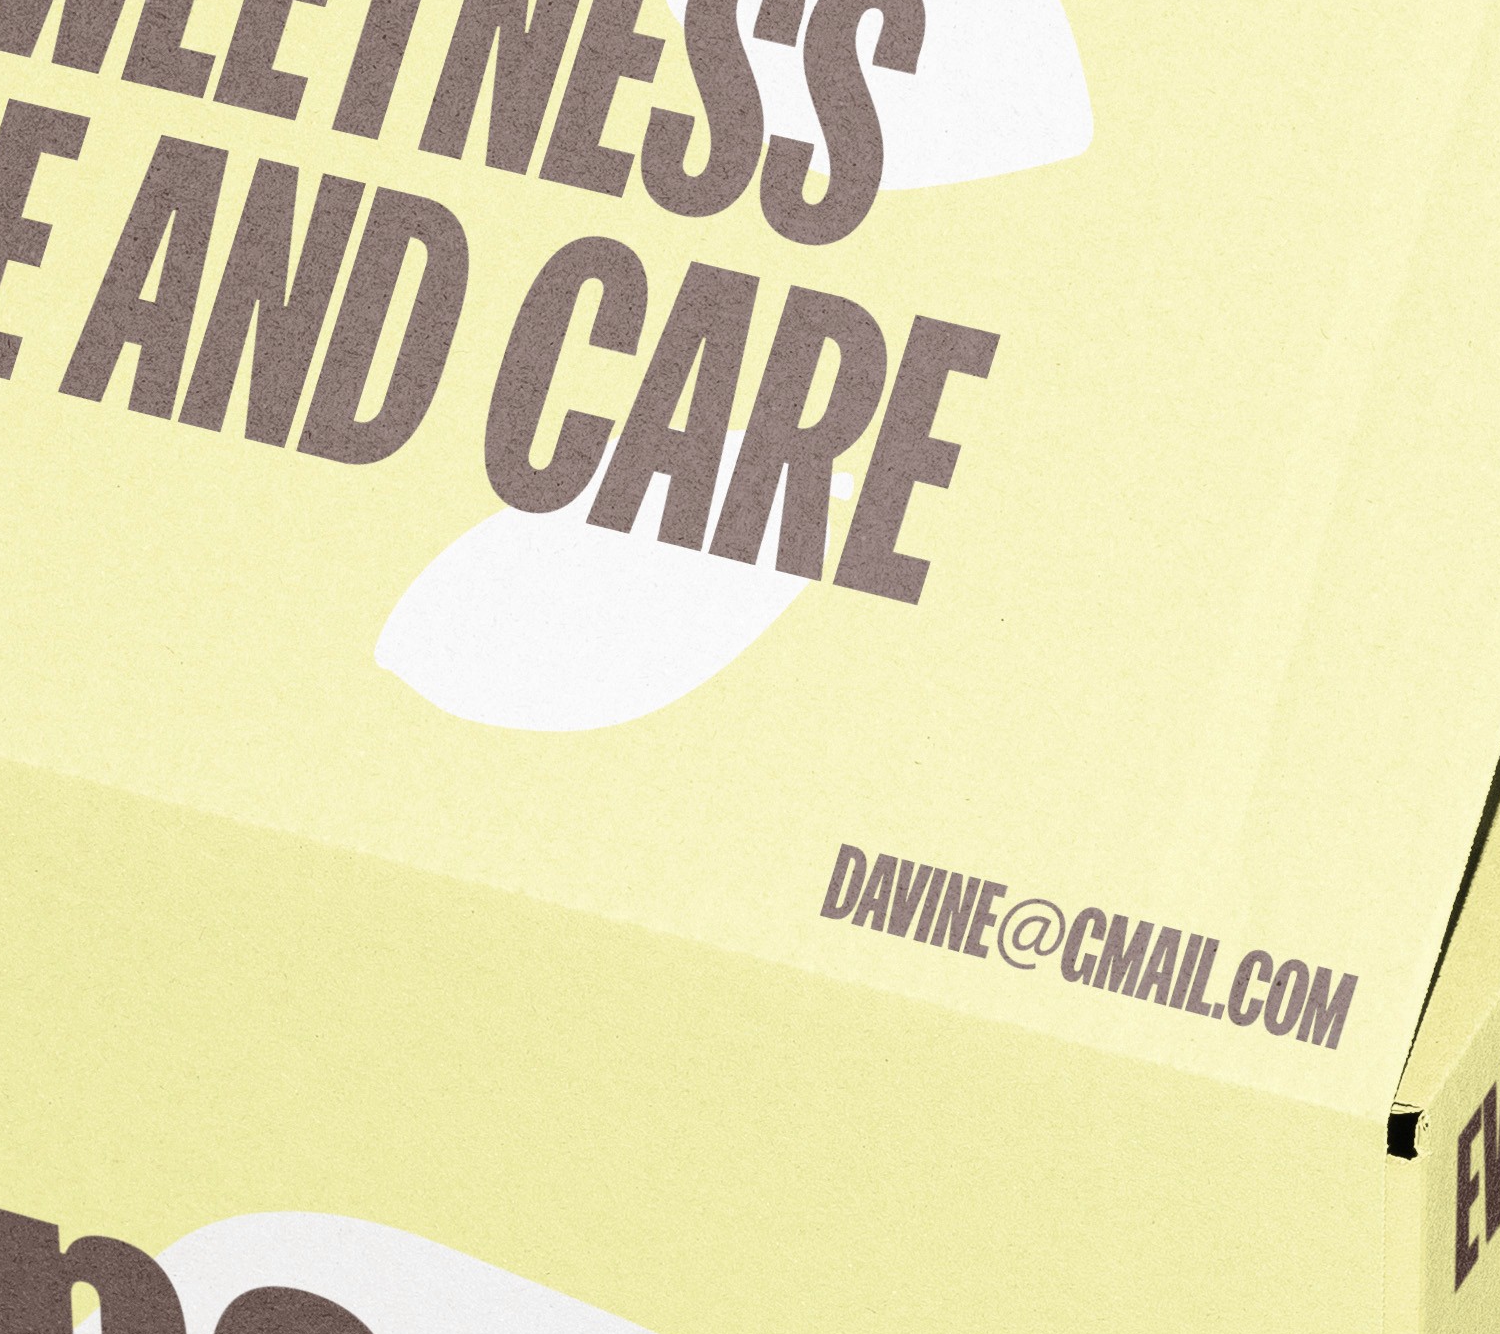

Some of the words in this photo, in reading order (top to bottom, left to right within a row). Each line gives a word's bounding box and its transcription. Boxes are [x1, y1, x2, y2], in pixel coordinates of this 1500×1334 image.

[58, 135, 469, 465] AND
[484, 236, 1000, 605] CARE
[820, 844, 1358, 1049] DAVINE@GMAIL.COM
